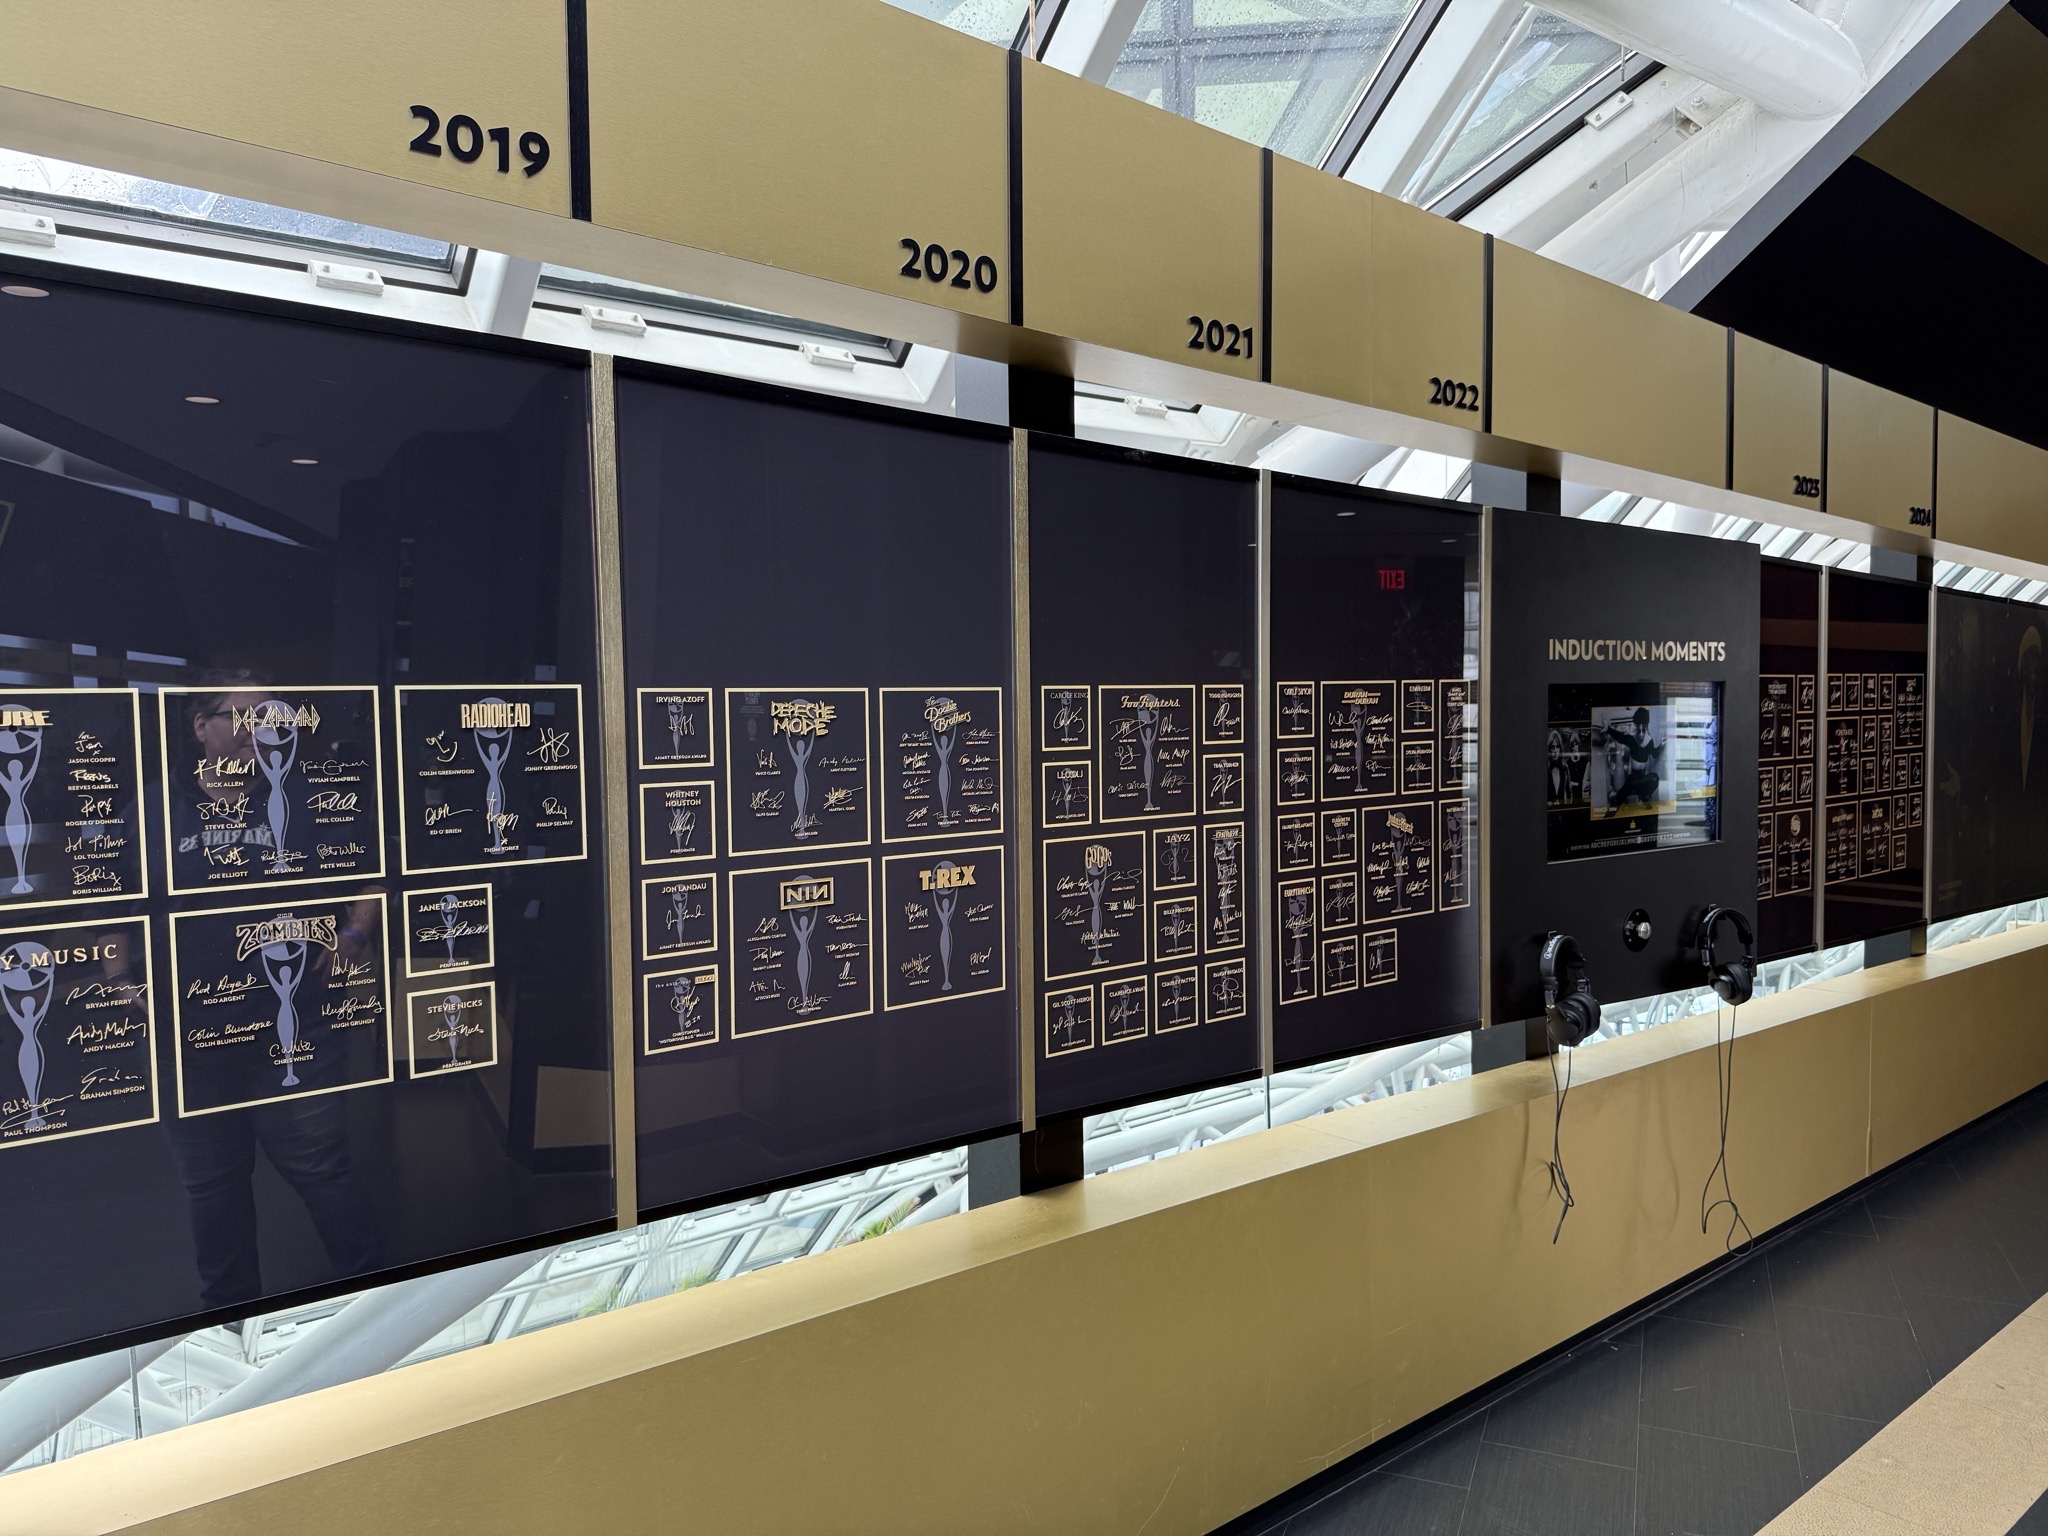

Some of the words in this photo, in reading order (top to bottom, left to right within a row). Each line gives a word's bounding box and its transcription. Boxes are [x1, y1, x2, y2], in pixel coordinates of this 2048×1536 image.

[409, 104, 551, 178] 2019
[900, 237, 998, 294] 2020
[1187, 315, 1254, 359] 2021
[1429, 376, 1479, 412] 2022
[1792, 474, 1820, 498] 2023
[1909, 507, 1932, 527] 2024
[1548, 638, 1646, 661] INDUCTION
[1651, 641, 1726, 662] MOMENTS
[770, 700, 837, 720] DEPECHE
[1121, 696, 1138, 708] Foo
[1140, 695, 1181, 710] Fighters
[232, 705, 258, 736] DEF
[260, 704, 321, 734] LEPPARD
[461, 703, 531, 728] RADIOHEAD
[934, 711, 972, 732] Brothers
[773, 717, 830, 737] MODE
[666, 790, 699, 798] WHITNEY
[666, 799, 701, 807] HOUSTON
[1164, 834, 1191, 844] JAY-Z
[87, 852, 119, 860] TOLHURST
[221, 871, 248, 879] ELLIOTT
[920, 865, 977, 891] T.REX
[92, 886, 122, 894] WILLIAMS
[662, 885, 677, 894] JON
[678, 883, 707, 892] LANDAU
[786, 884, 828, 903] NIN
[419, 902, 446, 912] JANET
[448, 899, 486, 909] JACKSON
[236, 915, 338, 961] ZOMBIES
[30, 944, 118, 967] MUSIC
[439, 960, 469, 969] PERFORMER
[345, 978, 376, 987] ATKINSON
[85, 1001, 110, 1010] BRYAN
[110, 998, 132, 1007] FERRY
[218, 994, 246, 1003] ARGENT
[427, 1002, 456, 1014] STEVIE
[457, 999, 483, 1010] NICKS
[350, 1018, 375, 1027] GRUNDY
[83, 1044, 104, 1053] ANDY
[105, 1040, 135, 1050] MACKAY
[195, 1041, 215, 1049] COLIN
[216, 1035, 255, 1046] BLUNSTONE
[274, 1057, 293, 1065] CHRIS
[293, 1055, 314, 1063] WHITE
[442, 1060, 472, 1069] PERFORMER
[80, 1091, 112, 1100] GRAHAM
[112, 1085, 145, 1096] SIMPSON
[4, 1129, 23, 1137] PAUL
[24, 1122, 68, 1134] THOMPSON
